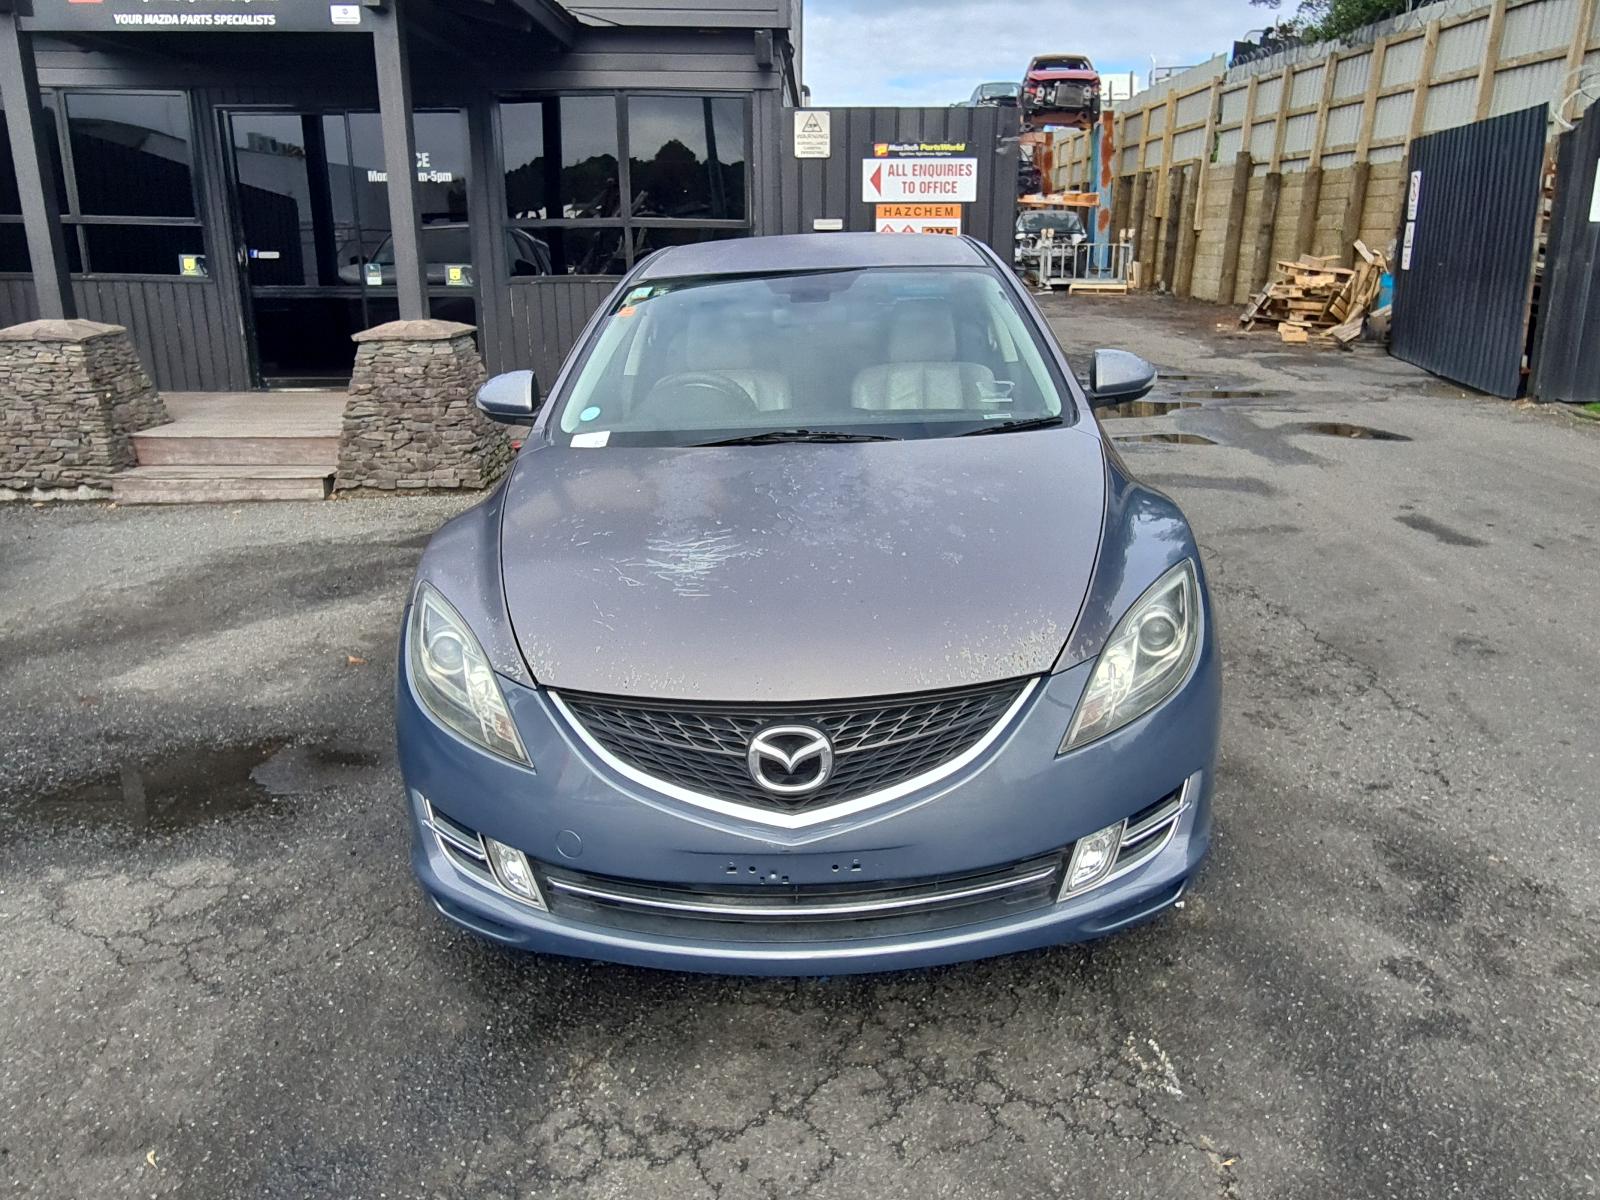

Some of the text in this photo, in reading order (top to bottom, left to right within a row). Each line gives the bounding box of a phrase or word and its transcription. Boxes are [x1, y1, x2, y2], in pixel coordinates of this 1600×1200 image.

[113, 14, 276, 26] YOUR MAZDA PARTS SPECIALISTS
[887, 164, 973, 178] ALL ENQUIRIES
[902, 181, 958, 194] TO OFFICE
[883, 207, 954, 217] HAZCHEM
